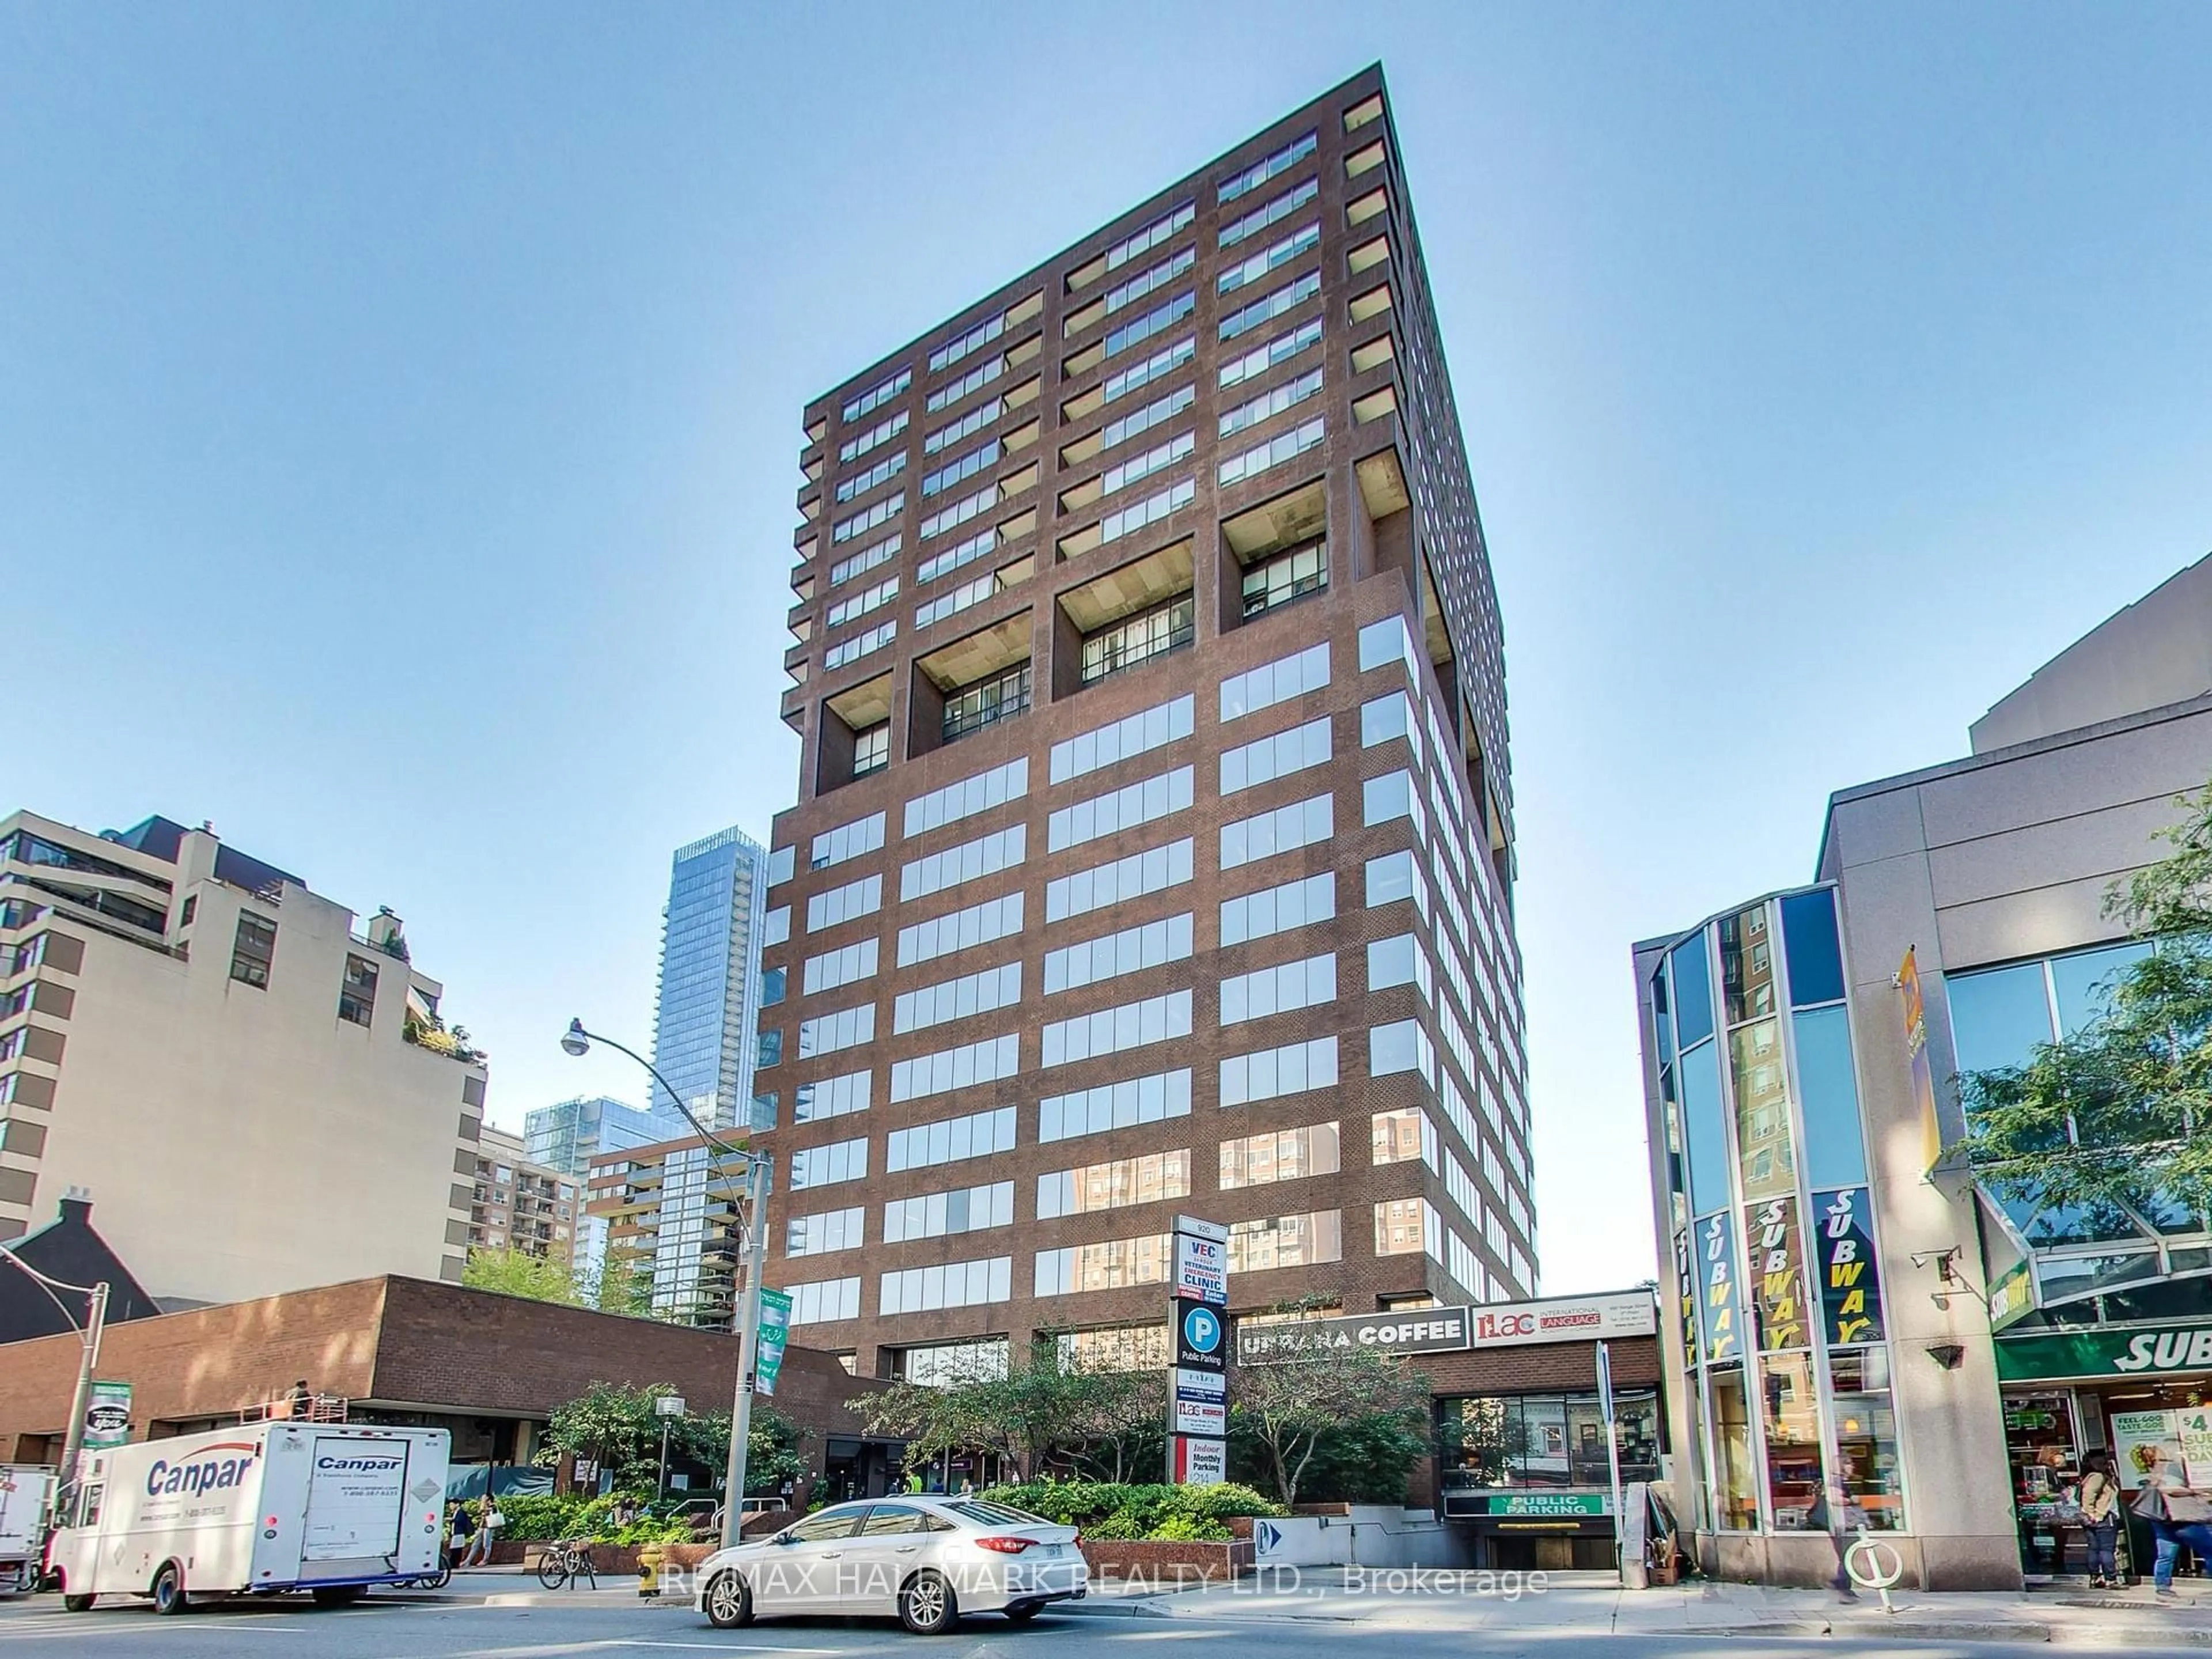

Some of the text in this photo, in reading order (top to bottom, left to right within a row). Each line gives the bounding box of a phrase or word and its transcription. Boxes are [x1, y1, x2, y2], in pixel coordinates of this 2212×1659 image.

[1198, 1224, 1210, 1234] 920
[1192, 1241, 1215, 1258] VEC
[1184, 1260, 1221, 1274] VETERINARY
[1184, 1267, 1221, 1281] EMERGENCY
[1824, 1190, 1872, 1344] SUBWAY
[1759, 1200, 1800, 1350] SUBWAY
[1184, 1274, 1221, 1291] CLINIC
[1705, 1214, 1734, 1360] SUBWAY
[1539, 1308, 1599, 1317] INTERNATIONAL
[1541, 1315, 1600, 1328] LANGUAGE
[1196, 1317, 1213, 1342] P
[1358, 1320, 1461, 1345] COFFEE
[1182, 1351, 1221, 1366] Public Parking
[1194, 1444, 1220, 1453] Indoor
[318, 1457, 402, 1471] Canpar
[1194, 1454, 1221, 1464] Monthly
[1194, 1463, 1219, 1473] Parking
[147, 1457, 253, 1498] Canpar
[1511, 1497, 1578, 1505] PUBLIC
[1506, 1506, 1588, 1514] PARKING
